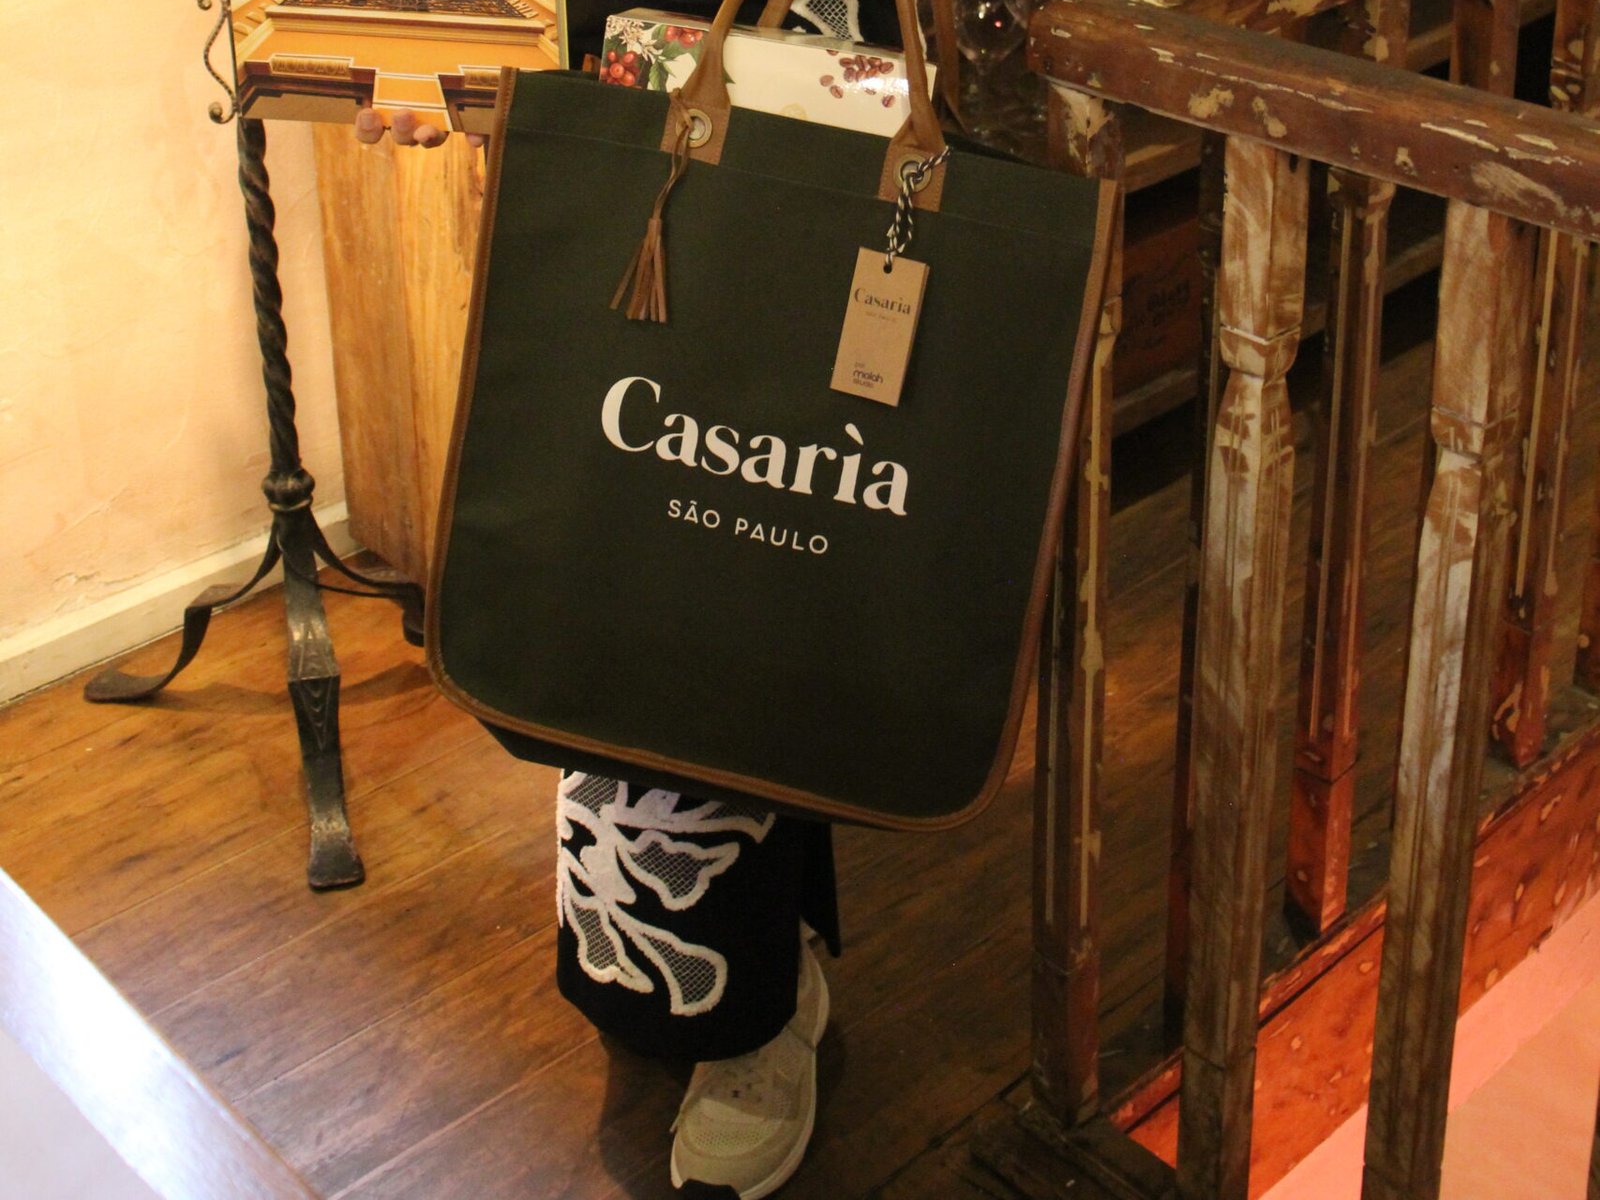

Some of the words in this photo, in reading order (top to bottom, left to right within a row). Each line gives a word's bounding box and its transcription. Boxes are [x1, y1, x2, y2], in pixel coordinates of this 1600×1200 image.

[601, 375, 909, 516] Casarìa
[667, 499, 721, 529] SÃO
[734, 517, 829, 555] PAULO
